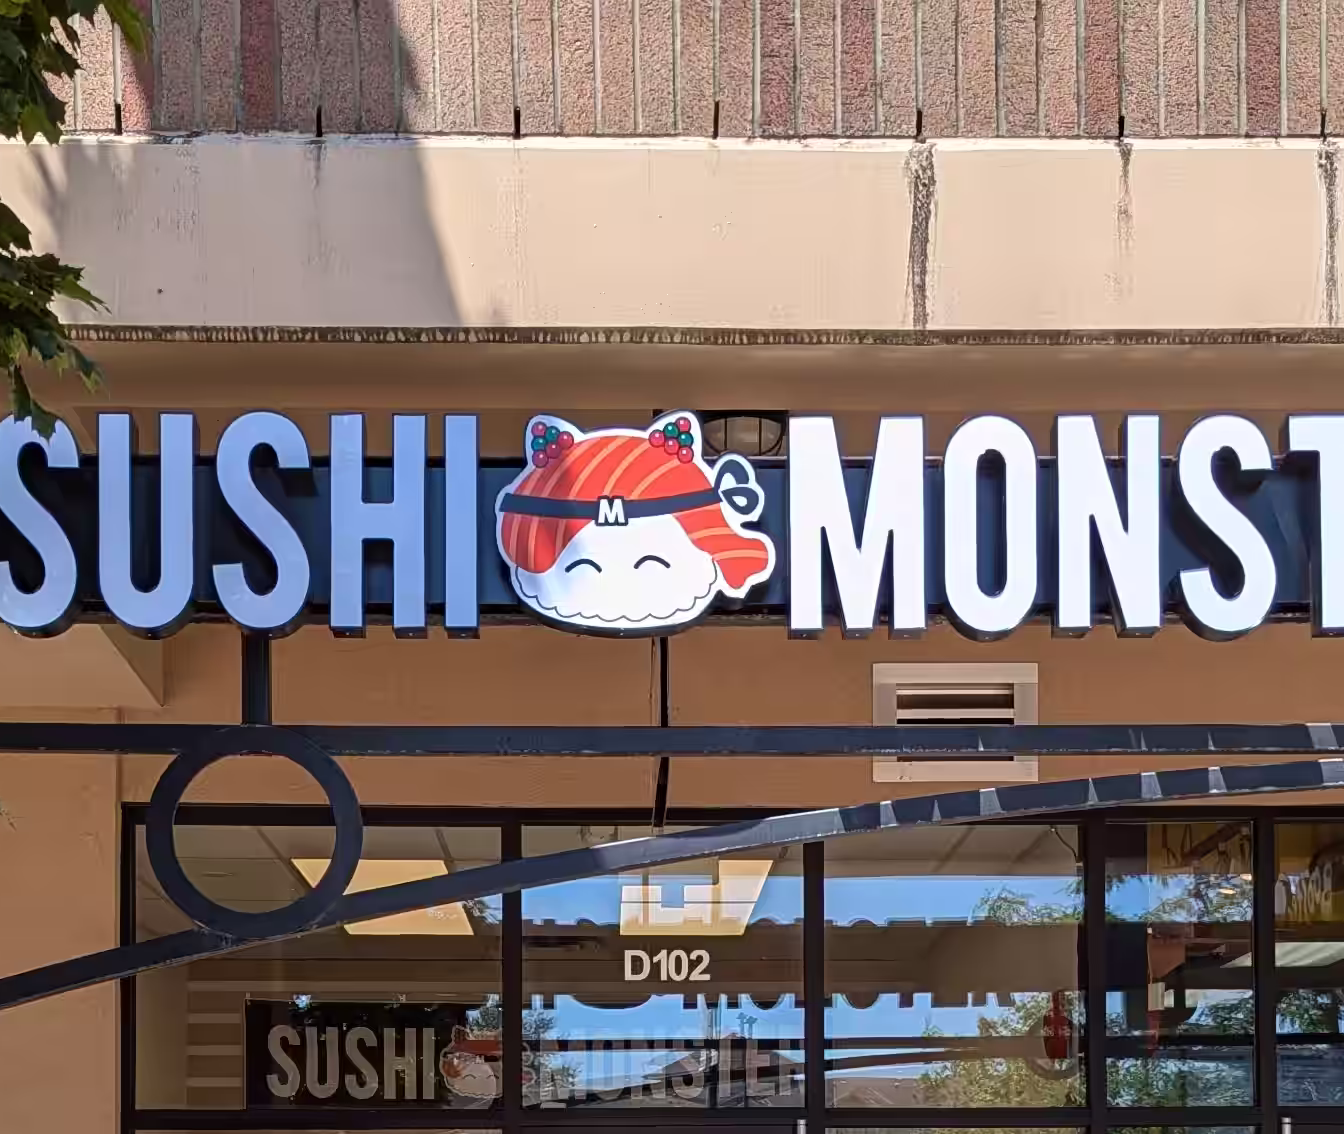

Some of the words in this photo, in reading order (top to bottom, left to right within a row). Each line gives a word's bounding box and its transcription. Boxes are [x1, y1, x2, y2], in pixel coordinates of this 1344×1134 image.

[597, 497, 626, 525] M
[624, 949, 711, 981] D102
[267, 1025, 436, 1100] SUSHI
